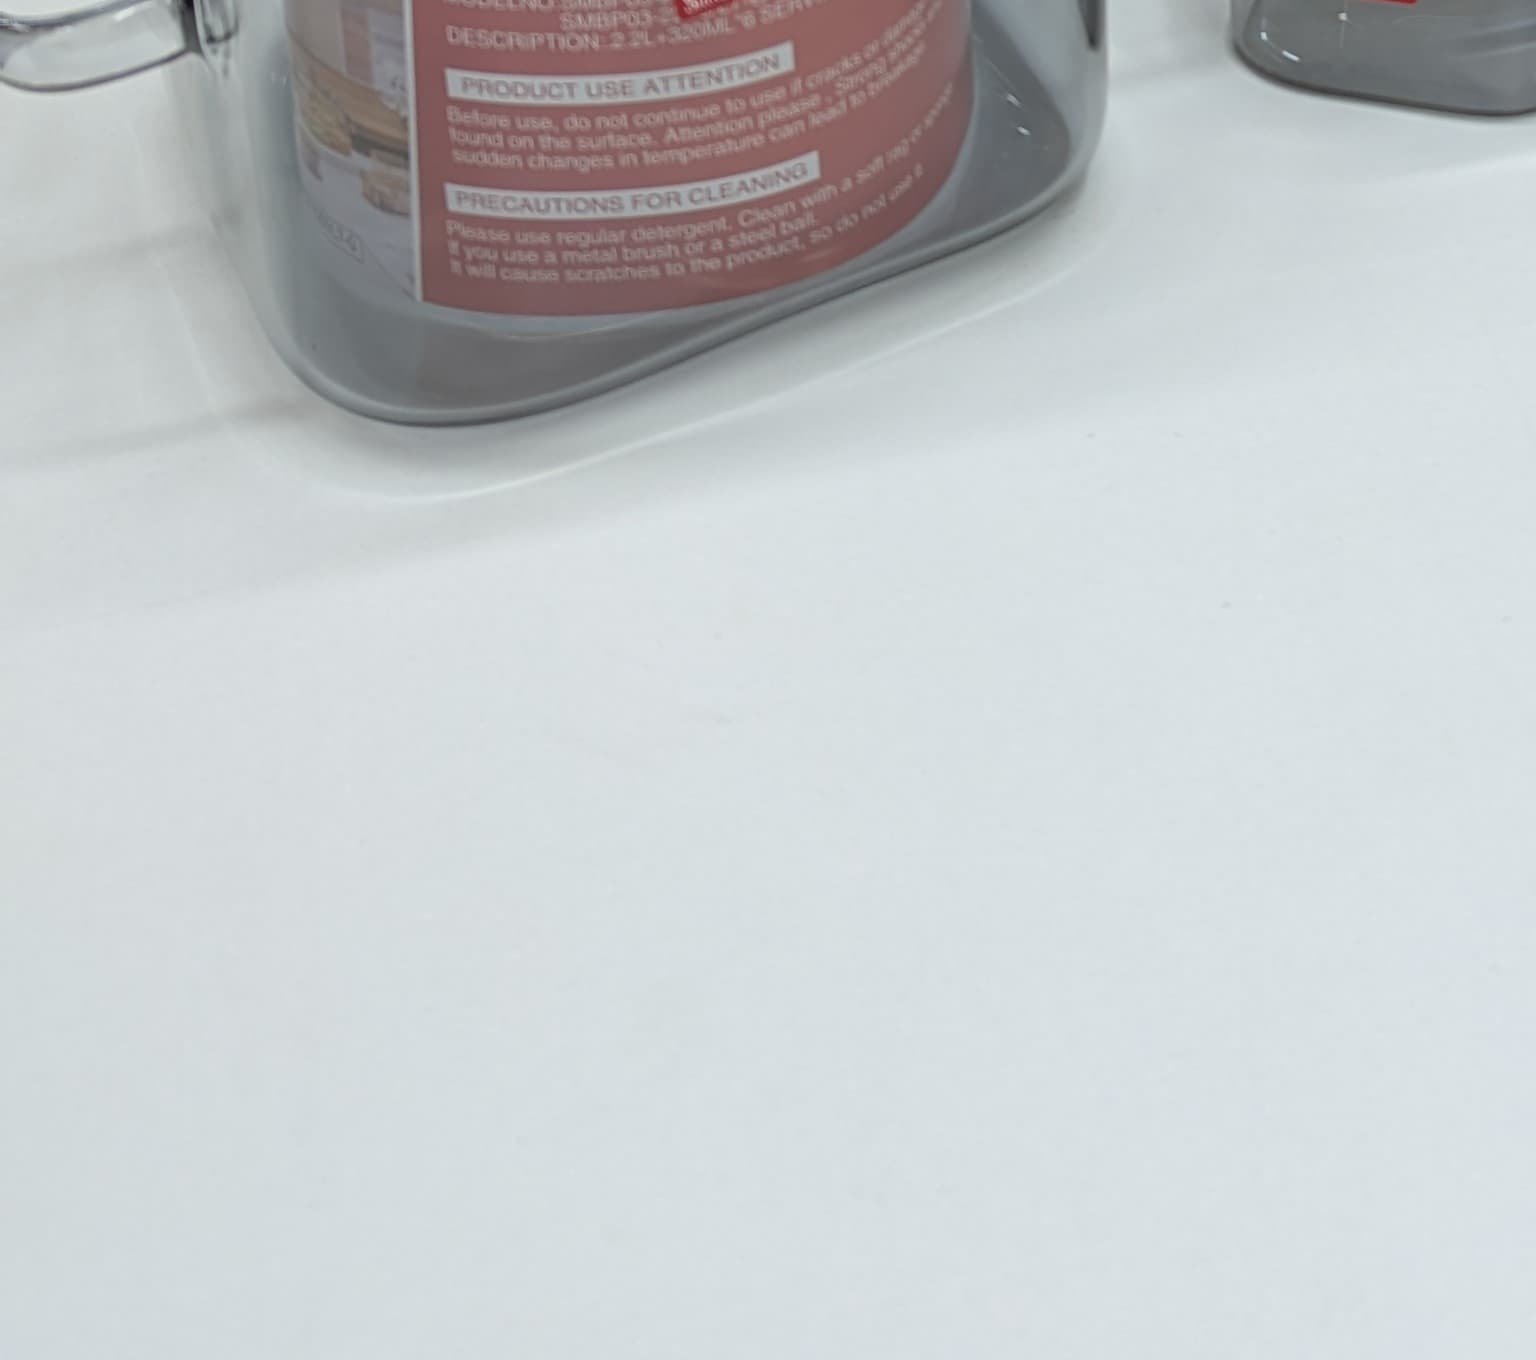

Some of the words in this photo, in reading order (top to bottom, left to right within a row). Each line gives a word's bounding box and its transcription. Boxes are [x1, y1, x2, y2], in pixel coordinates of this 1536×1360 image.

[446, 103, 511, 130] Before
[563, 111, 592, 129] do
[596, 111, 628, 129] not
[632, 102, 721, 128] continue
[725, 97, 747, 116] to
[750, 87, 788, 109] use
[805, 51, 864, 89] cracks
[460, 76, 578, 101] PRODUCT
[585, 77, 634, 100] USE
[643, 52, 781, 95] ATTENTION
[449, 125, 503, 149] found
[508, 133, 535, 150] on
[539, 130, 571, 151] the
[664, 114, 754, 146] Attention
[452, 146, 523, 170] sudden
[527, 152, 615, 173] changes
[619, 150, 639, 167] in
[643, 132, 765, 165] temperature
[768, 119, 807, 142] can
[455, 189, 625, 215] PRECAUTIONS
[631, 190, 683, 212] FOR
[688, 161, 808, 206] CLEANING
[446, 218, 511, 243] Please
[516, 228, 551, 244] use
[556, 227, 625, 248] regular
[736, 199, 797, 228] Clean
[798, 183, 839, 209] with
[462, 245, 499, 262] you
[503, 247, 539, 264] use
[543, 249, 557, 265] a
[561, 246, 618, 265] metal
[622, 240, 682, 262] brush
[710, 234, 725, 252] a
[727, 222, 778, 250] steel
[465, 262, 497, 280] will
[501, 266, 560, 284] cause
[565, 263, 660, 284] scratches
[664, 261, 686, 277] to
[690, 252, 721, 274] the
[809, 223, 833, 244] so
[835, 211, 859, 233] do
